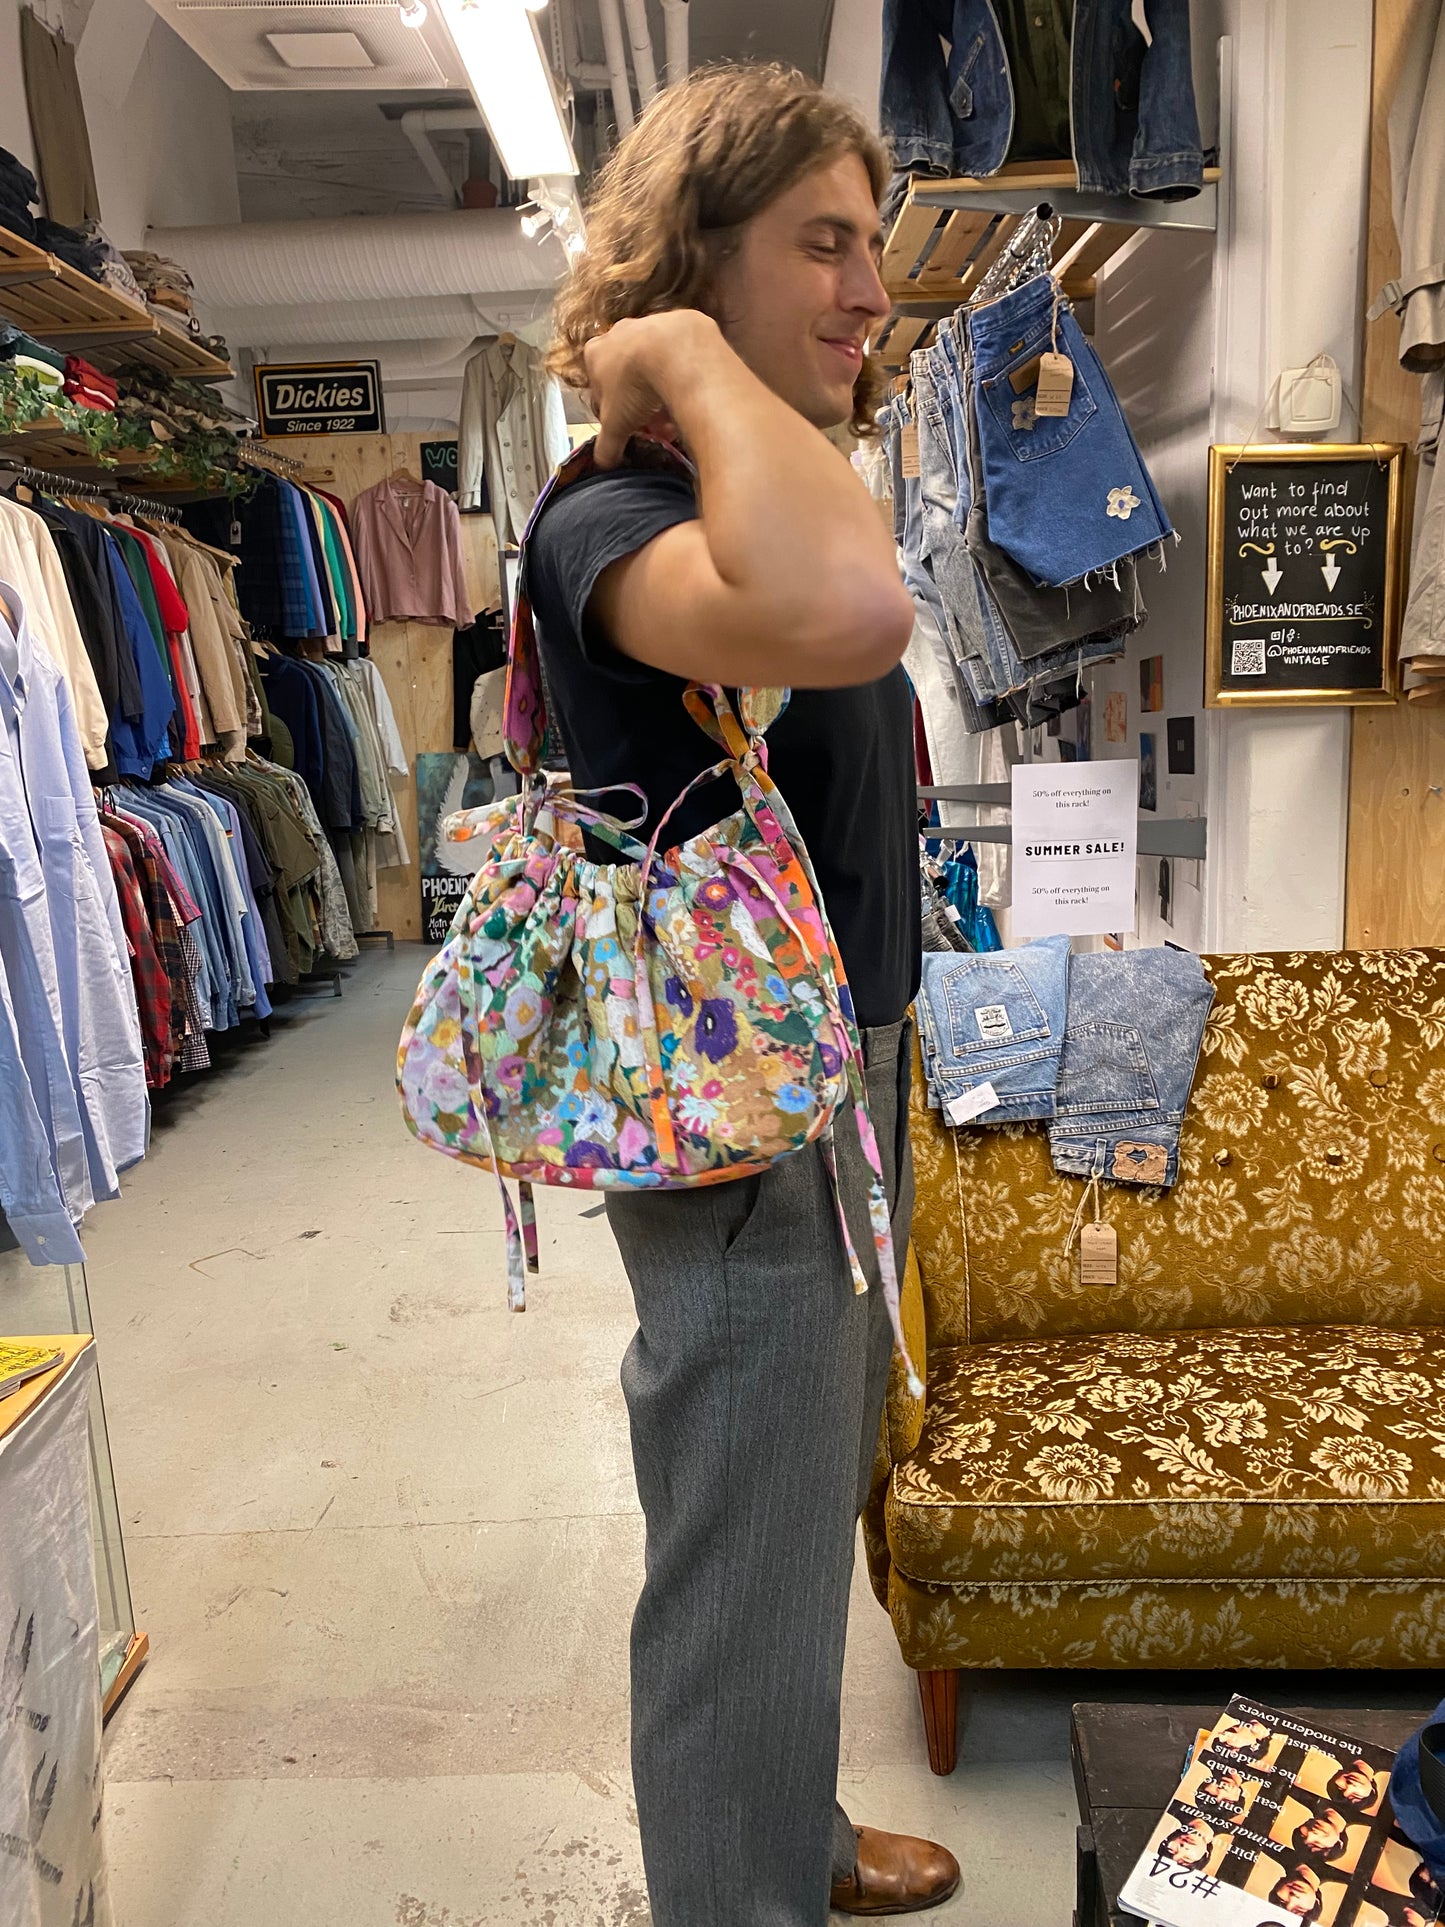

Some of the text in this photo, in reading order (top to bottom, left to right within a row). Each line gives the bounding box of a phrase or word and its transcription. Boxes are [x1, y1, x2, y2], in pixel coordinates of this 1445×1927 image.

[275, 382, 365, 410] Dickies
[286, 418, 355, 432] Since 1922
[1241, 479, 1349, 505] Want to find
[1239, 502, 1370, 520] out more about
[1237, 520, 1371, 546] what we are up
[1267, 644, 1371, 657] @PHOENIXANDFRIENDS
[1283, 655, 1330, 666] VINTAGE
[1032, 790, 1050, 798] 50%
[1050, 789, 1062, 797] off
[1062, 788, 1101, 798] everything
[1055, 800, 1090, 808] this rack!
[1025, 842, 1125, 856] SUMMER SALE!
[1032, 887, 1049, 895] 50%
[1061, 885, 1100, 895] everything
[1055, 896, 1089, 905] this rack!
[1237, 1702, 1280, 1726] lovers
[1280, 1717, 1338, 1747] modern
[1337, 1739, 1364, 1757] the
[1205, 1757, 1272, 1793] stereolab
[1179, 1803, 1287, 1855] primal scream
[1149, 1853, 1222, 1900] #24
